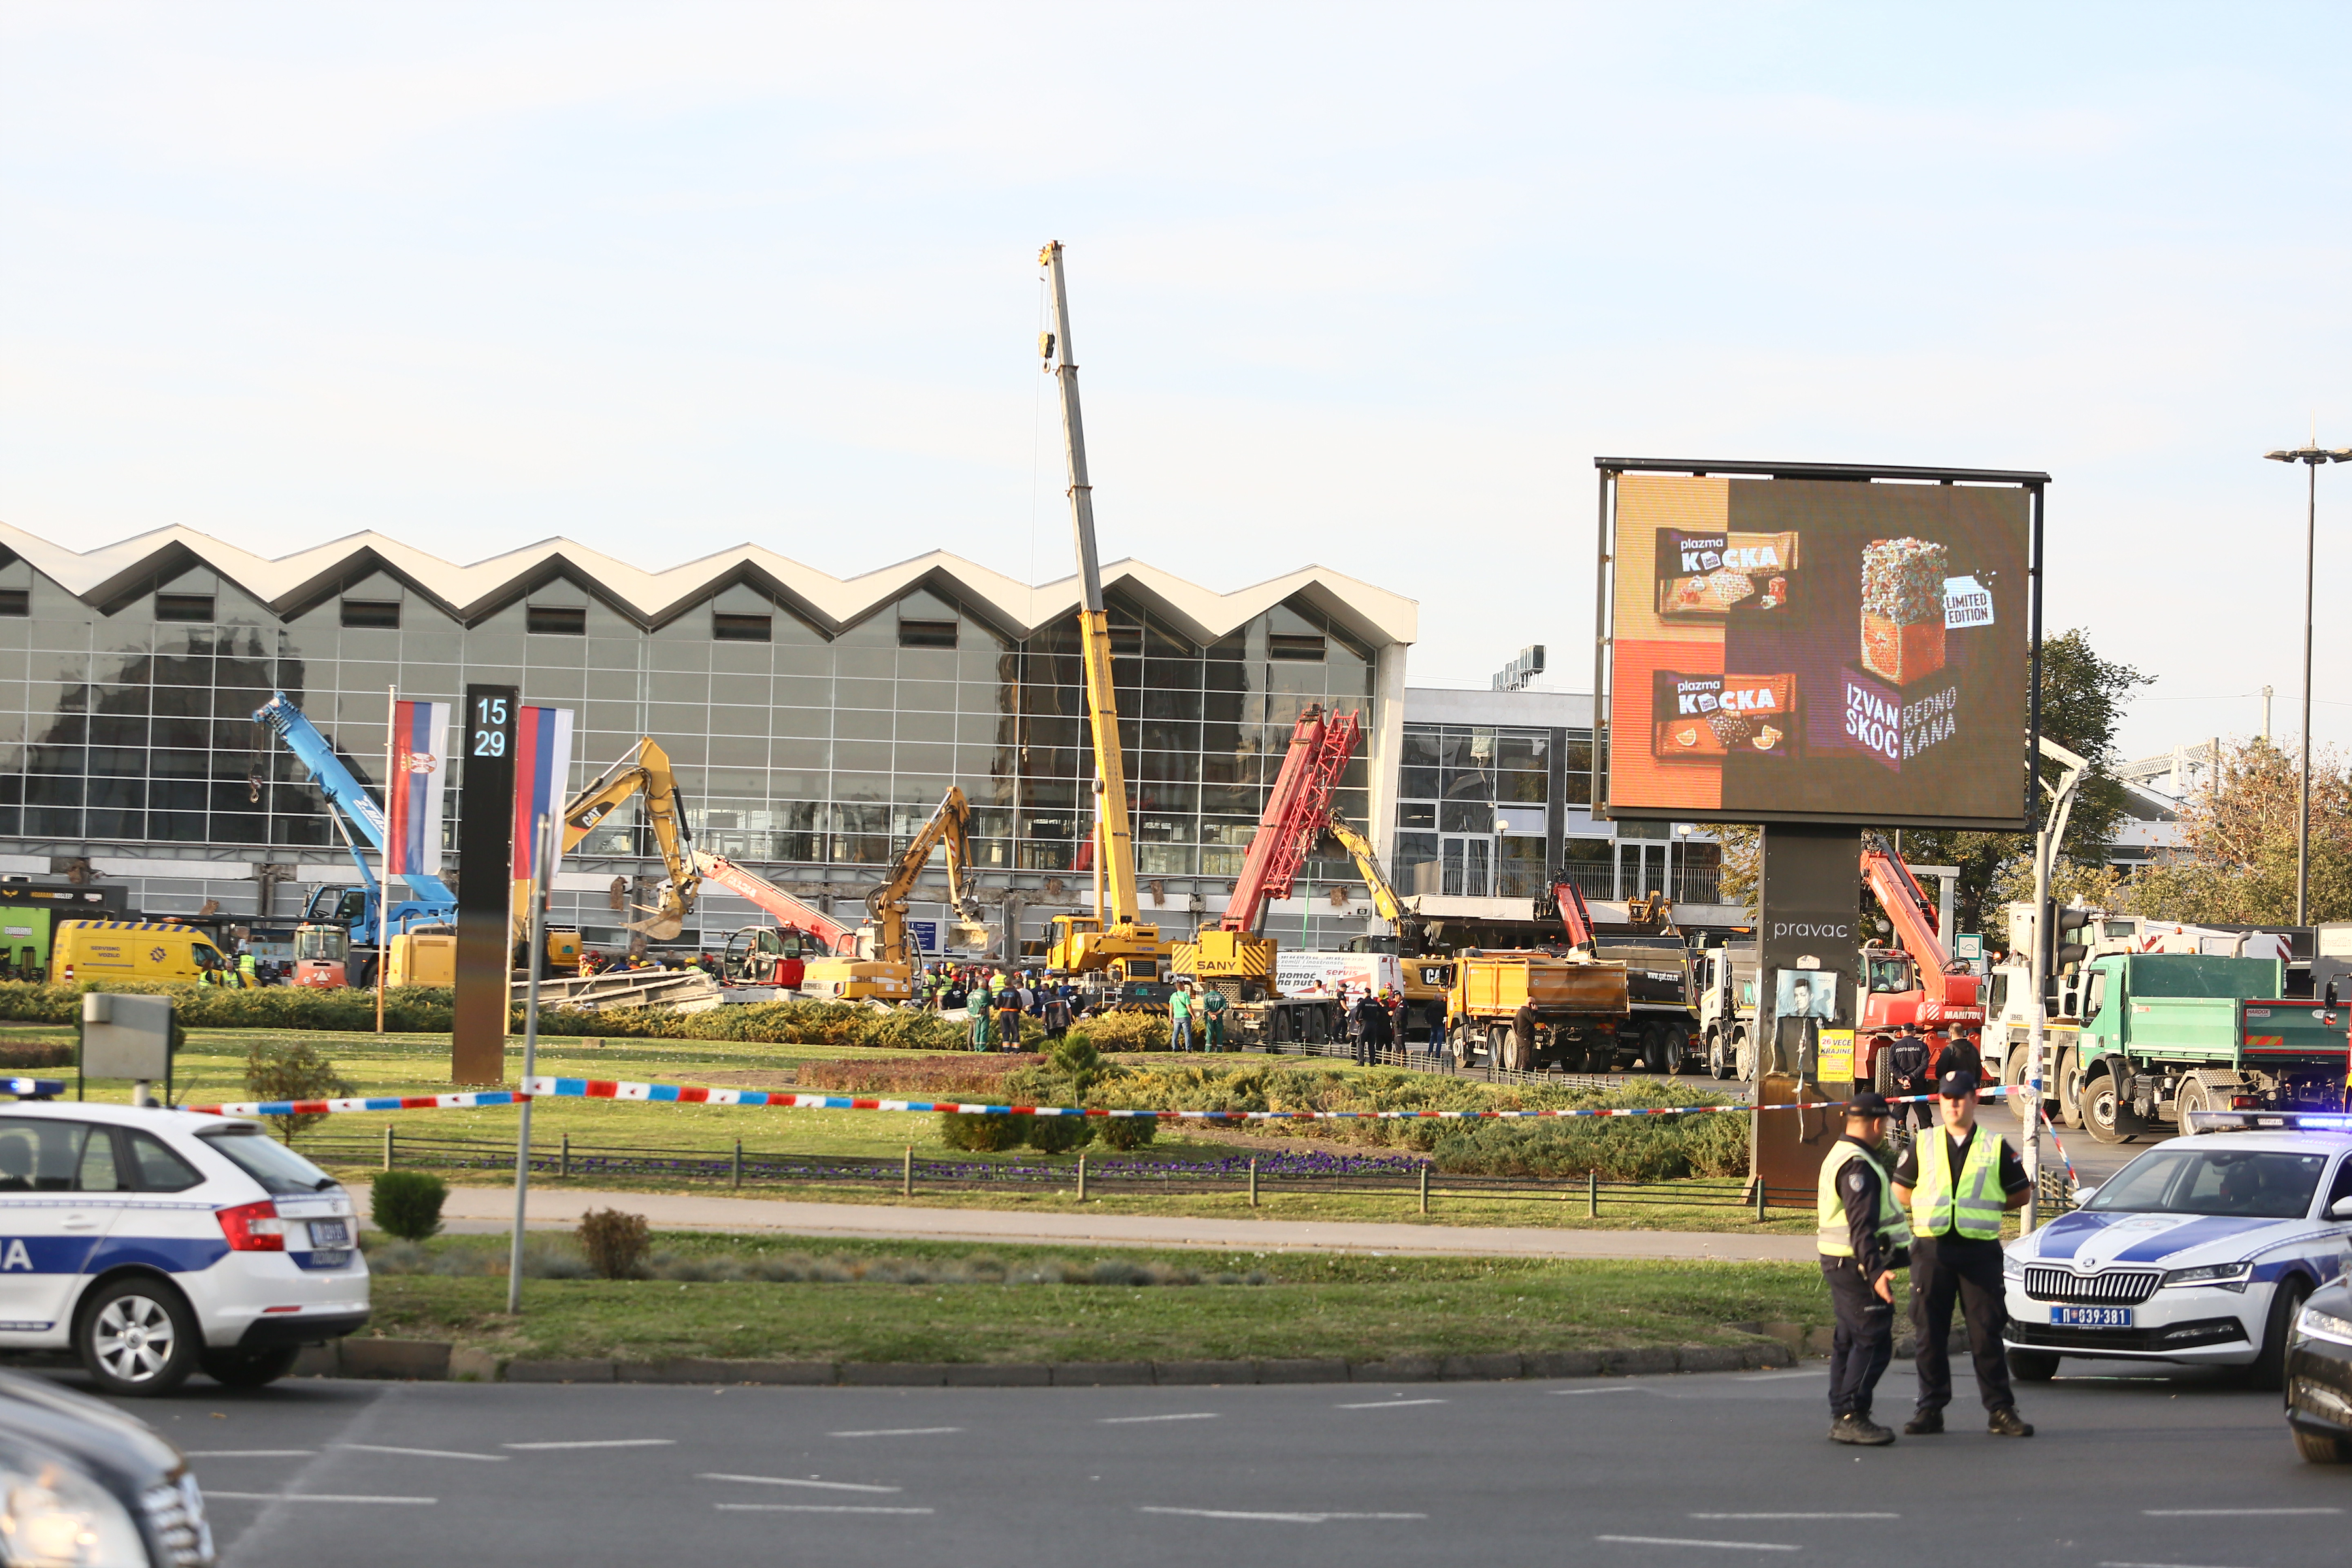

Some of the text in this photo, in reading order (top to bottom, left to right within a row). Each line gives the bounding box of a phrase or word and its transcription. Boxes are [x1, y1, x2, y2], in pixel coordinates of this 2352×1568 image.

[1680, 538, 1724, 551] plazma
[1946, 593, 1987, 610] LIMITED
[1948, 607, 1988, 623] EDITION
[1677, 680, 1720, 693] plazma
[478, 698, 507, 725] 15
[1846, 683, 1899, 729] IZVAN
[1903, 687, 1956, 732] REDNO
[1846, 708, 1899, 759] SKOC
[1903, 712, 1956, 760] KANA
[474, 730, 506, 757] 29
[582, 807, 602, 827] CAT
[5, 926, 33, 936] GUARANA
[1774, 923, 1848, 939] pravac
[1196, 960, 1237, 971] SANY
[1279, 971, 1317, 979] pomoć
[1426, 968, 1440, 985] CA
[1647, 972, 1679, 982] www.gat.co.rs
[1944, 1010, 1983, 1020] MANITOU
